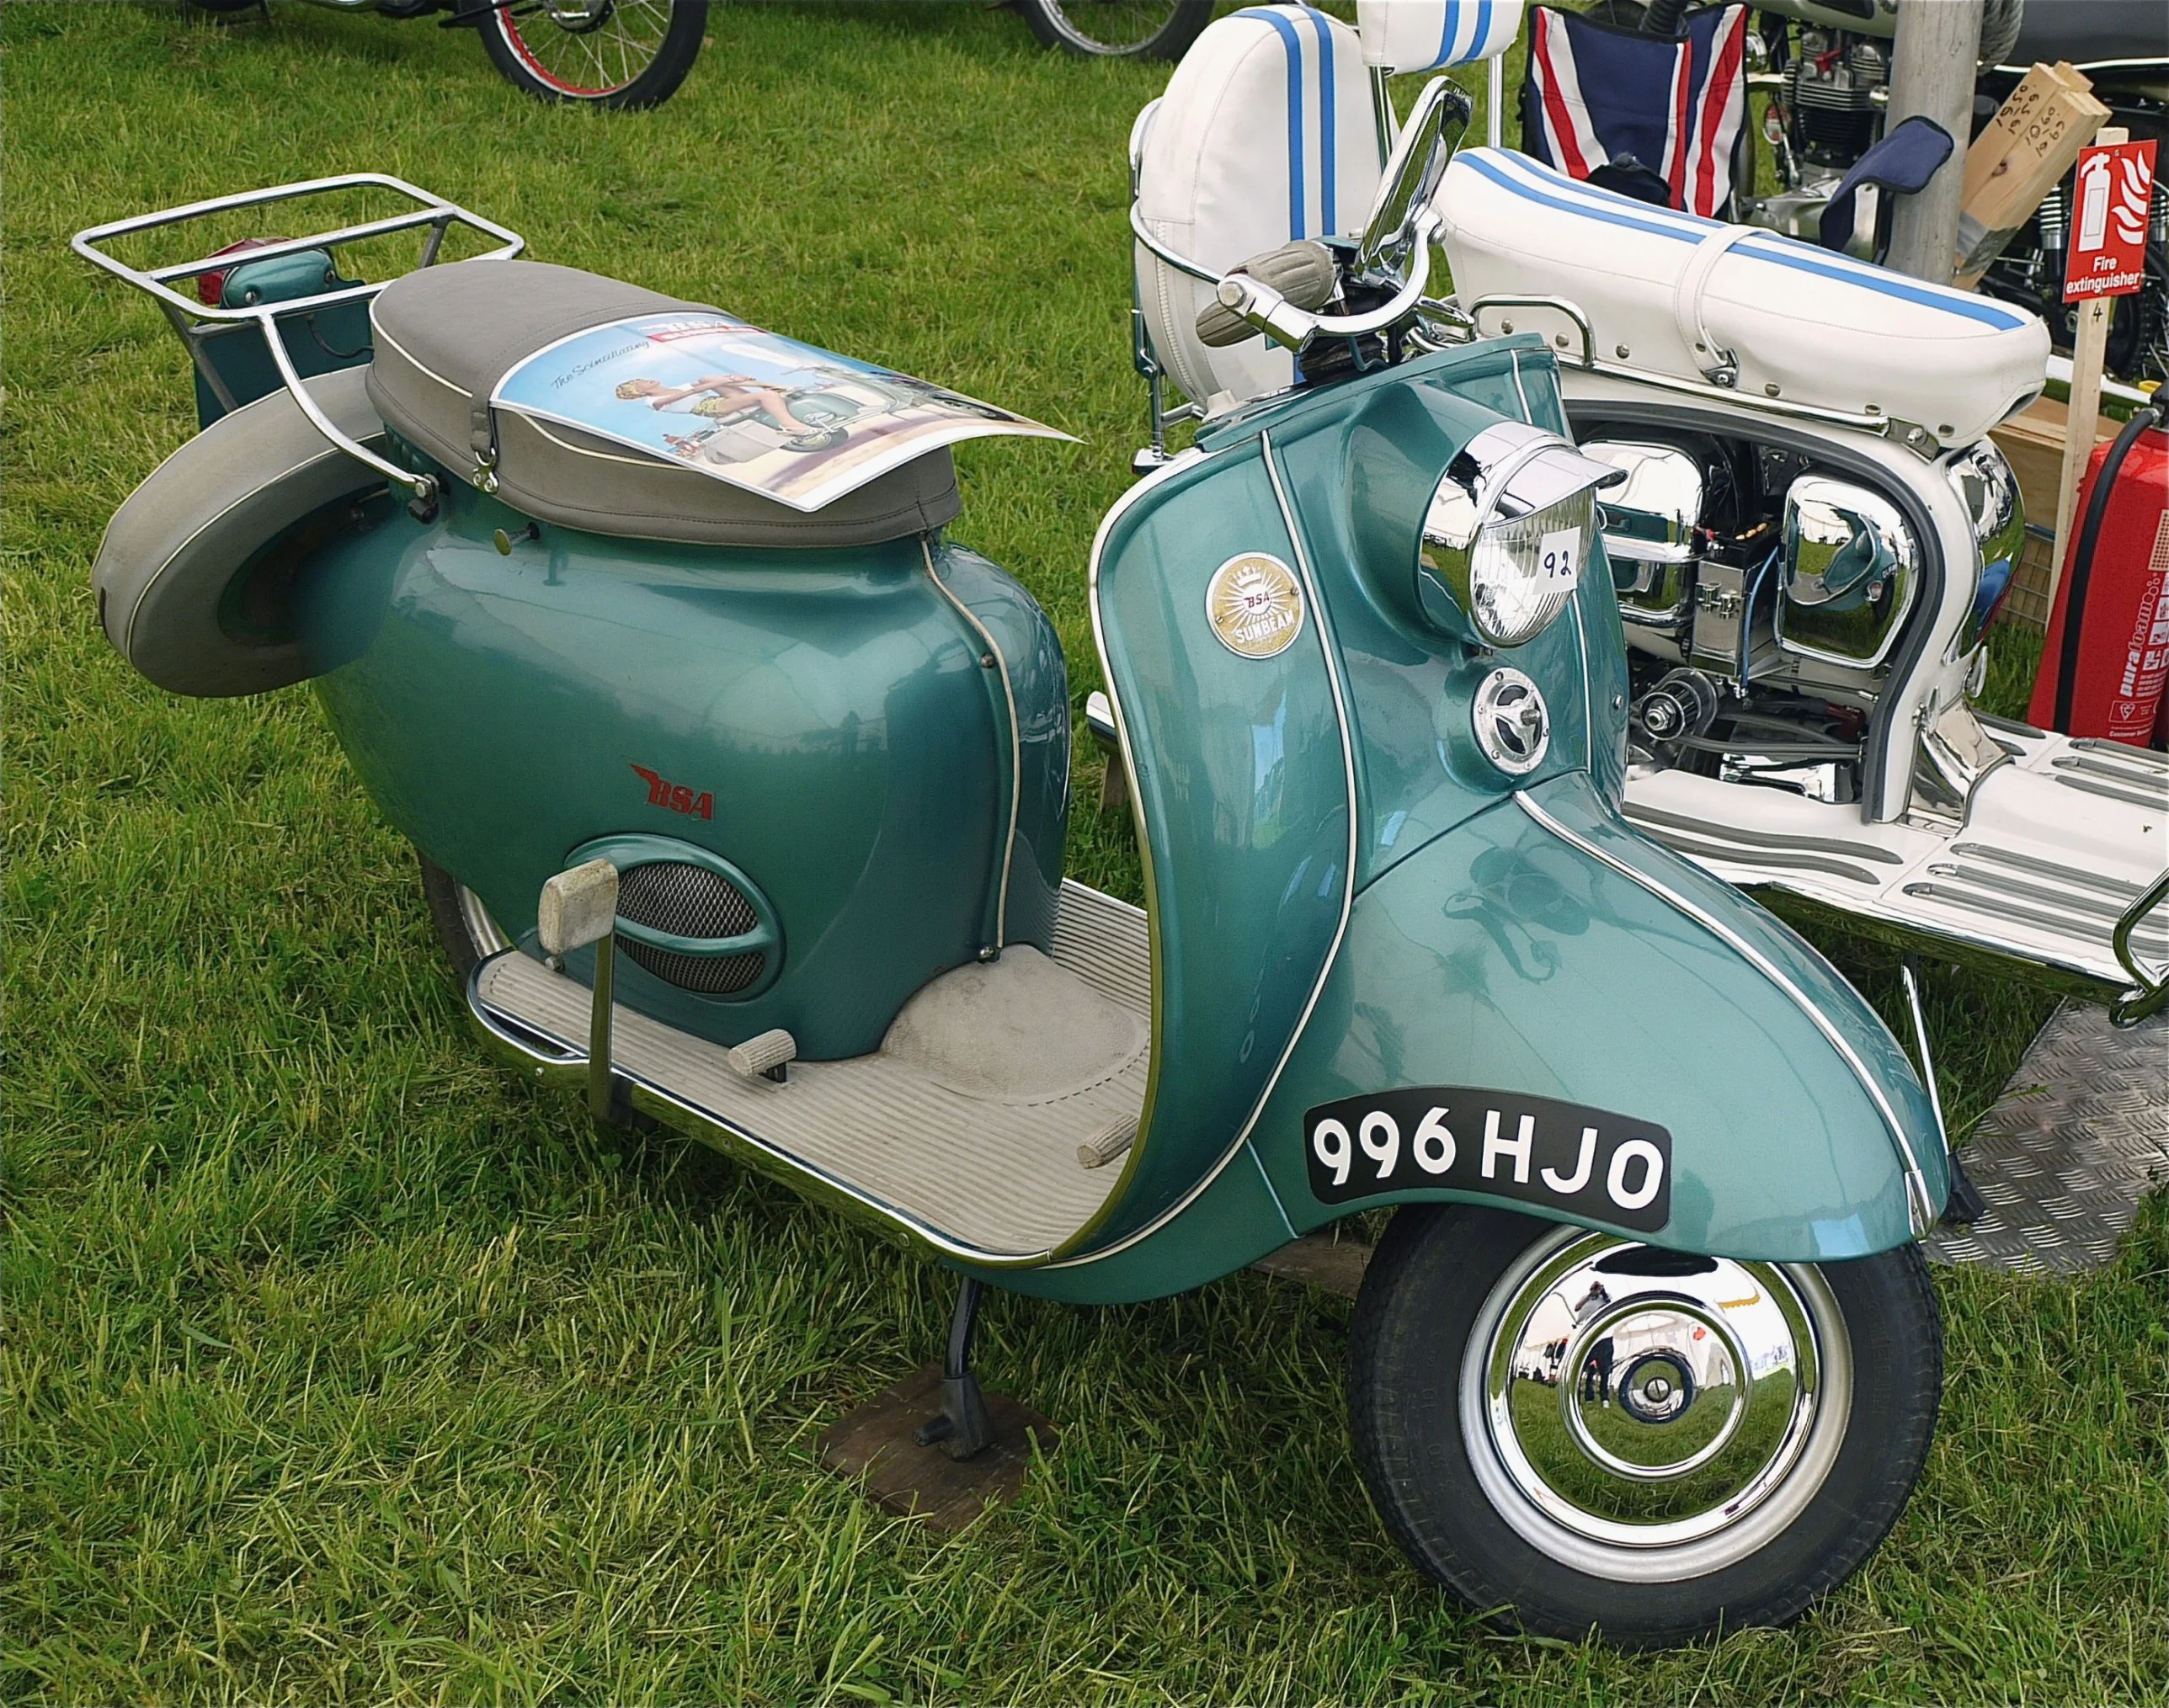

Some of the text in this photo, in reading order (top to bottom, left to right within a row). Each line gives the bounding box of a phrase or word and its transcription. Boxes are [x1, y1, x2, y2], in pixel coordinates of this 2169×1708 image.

[2092, 256, 2118, 272] Fire
[2065, 271, 2140, 295] extinguisher
[2092, 301, 2103, 322] 4
[550, 341, 650, 390] The Scintillating
[1543, 551, 1572, 578] 92
[1244, 591, 1271, 609] BSA
[1235, 609, 1295, 644] SUNBEAM
[2119, 602, 2154, 698] purafoam
[630, 764, 713, 822] BSA
[1314, 1106, 1665, 1210] 996 HJO
